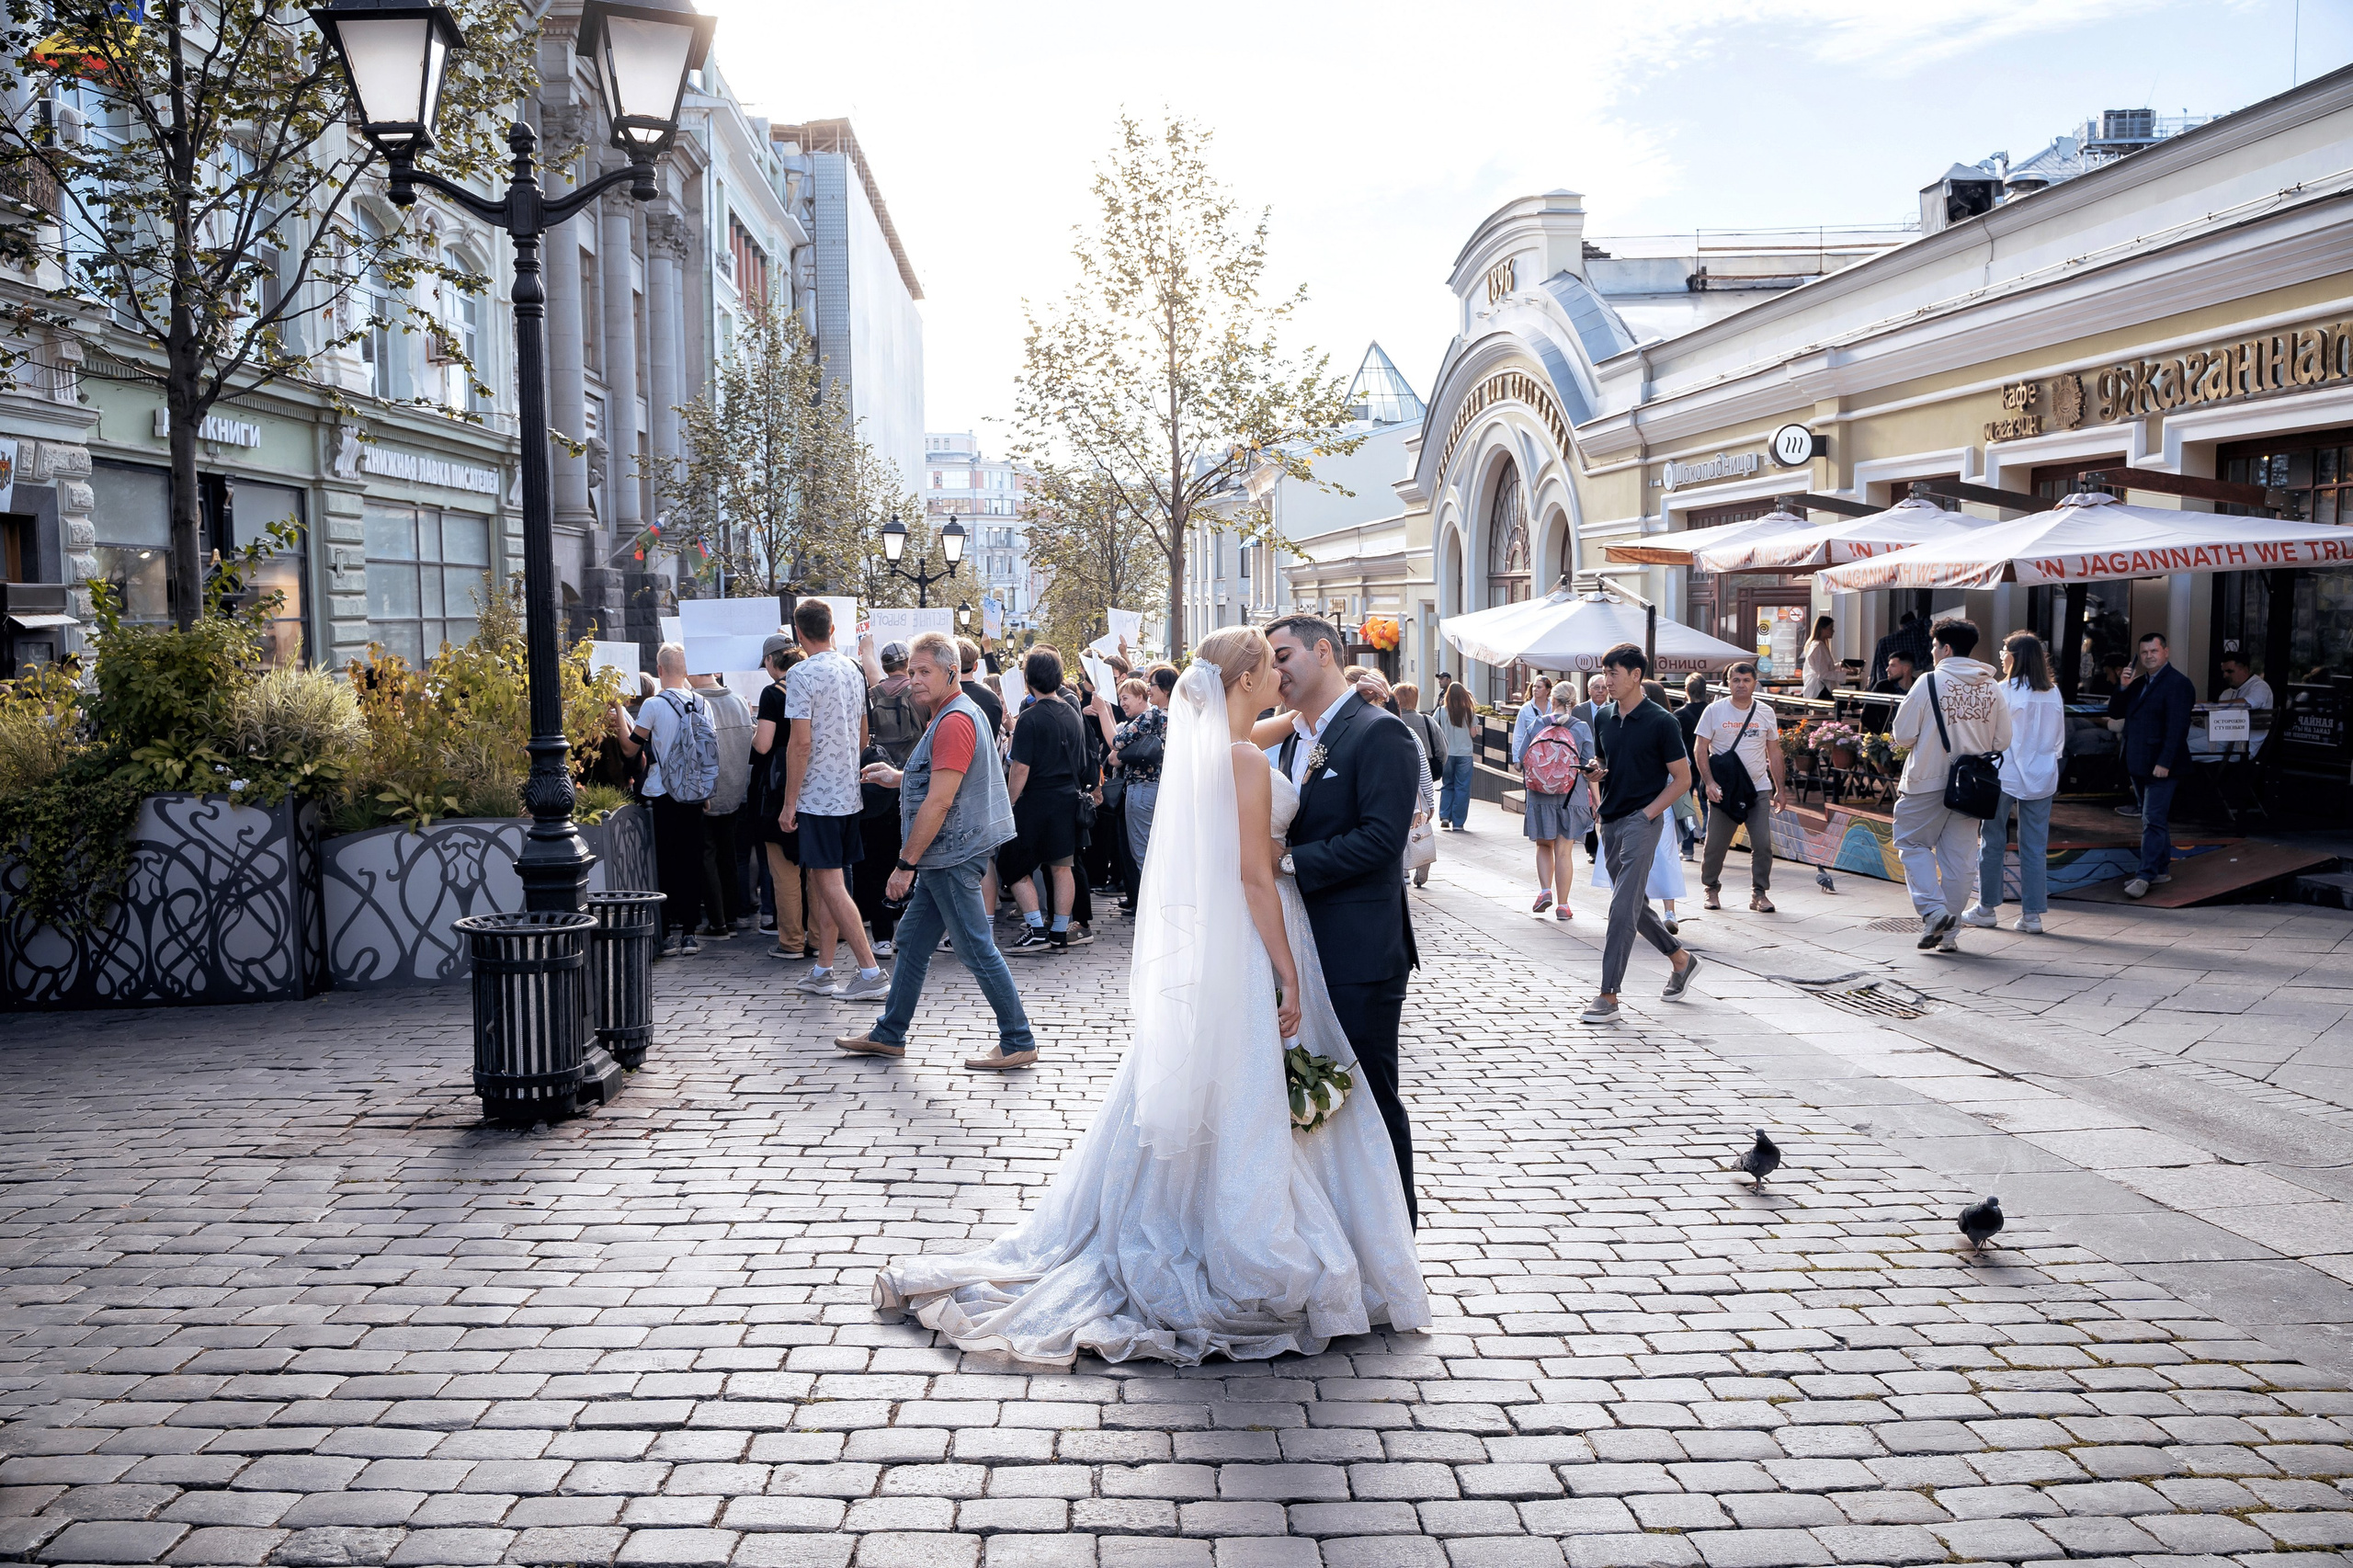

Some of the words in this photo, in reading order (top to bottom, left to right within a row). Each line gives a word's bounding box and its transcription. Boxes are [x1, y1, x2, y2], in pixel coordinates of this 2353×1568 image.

[1487, 258, 1515, 305] 1896
[2001, 381, 2039, 411] кафе
[206, 415, 261, 448] КНИГИ
[1984, 415, 2042, 440] магазин
[364, 446, 416, 481] КНИЖНАЯ
[418, 458, 450, 486] ЛАВКА
[451, 464, 499, 494] ПИСАТЕЛЕЙ
[1674, 452, 1757, 485] Шоколадница
[1848, 543, 1872, 558] IN
[2035, 558, 2065, 578] IN
[2076, 544, 2247, 576] JAGANNATH
[2253, 541, 2298, 562] WE
[1842, 563, 1911, 588] JAGANNATH
[1916, 563, 1937, 582] WE
[1722, 721, 1759, 729] chanes
